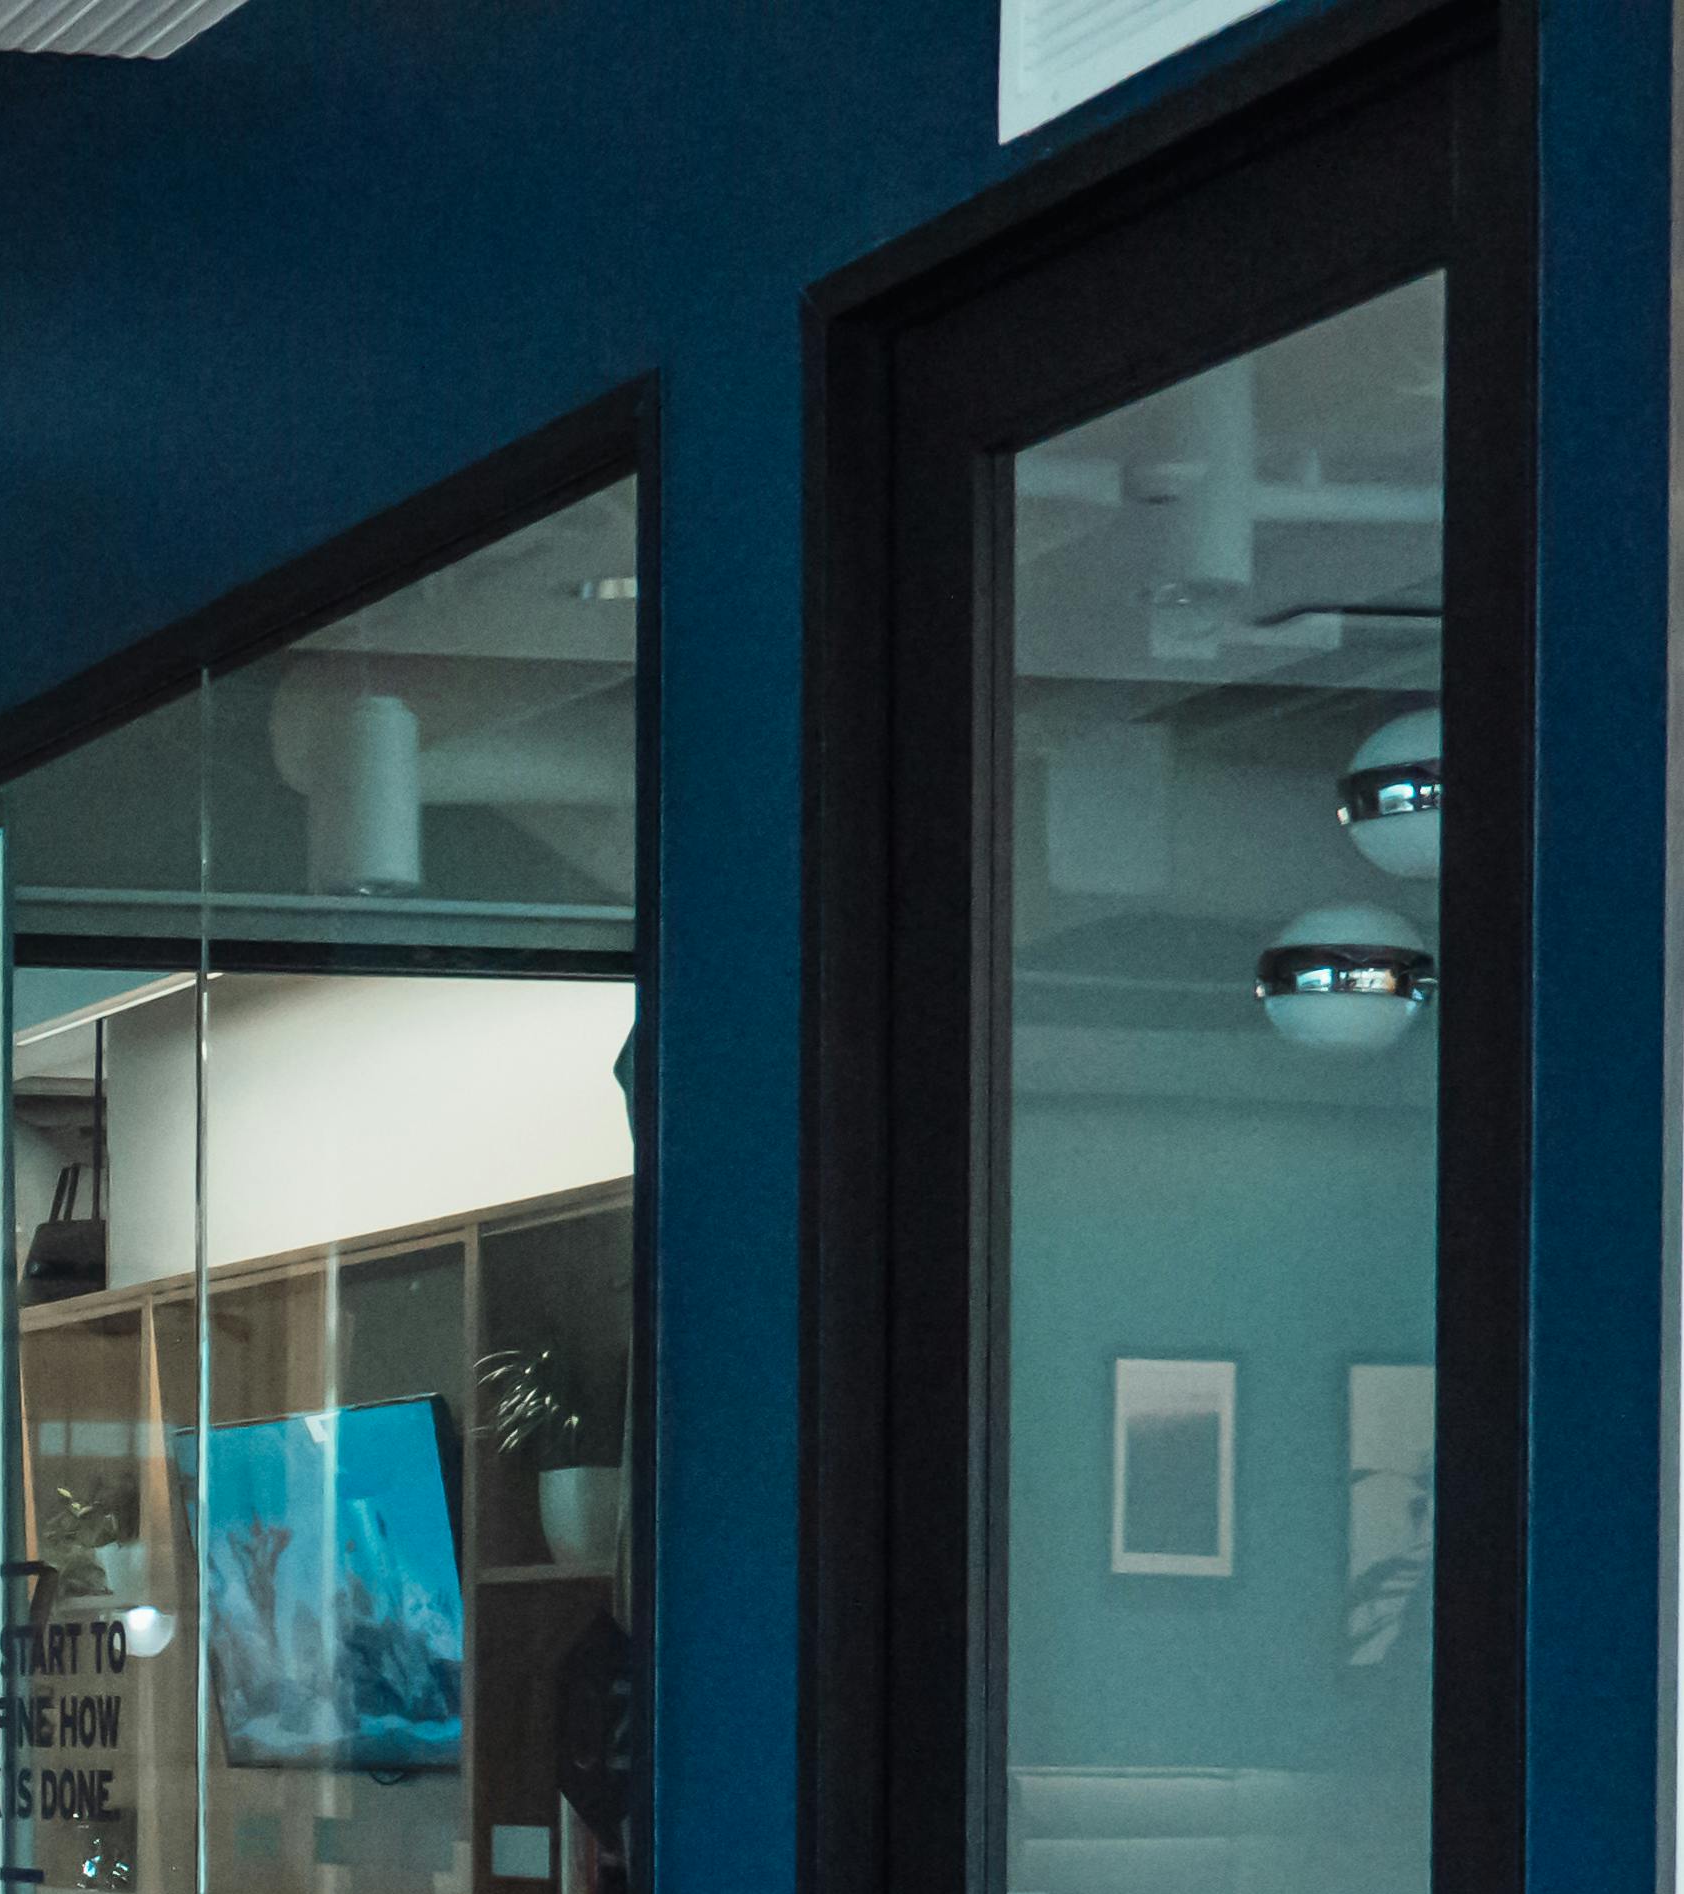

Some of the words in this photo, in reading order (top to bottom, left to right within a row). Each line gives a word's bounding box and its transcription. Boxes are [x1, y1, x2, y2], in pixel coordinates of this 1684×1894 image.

[0, 1623, 81, 1676] START
[91, 1620, 127, 1674] TO
[60, 1695, 121, 1747] HOW
[6, 1767, 33, 1819] IS
[41, 1768, 121, 1821] DONE.
